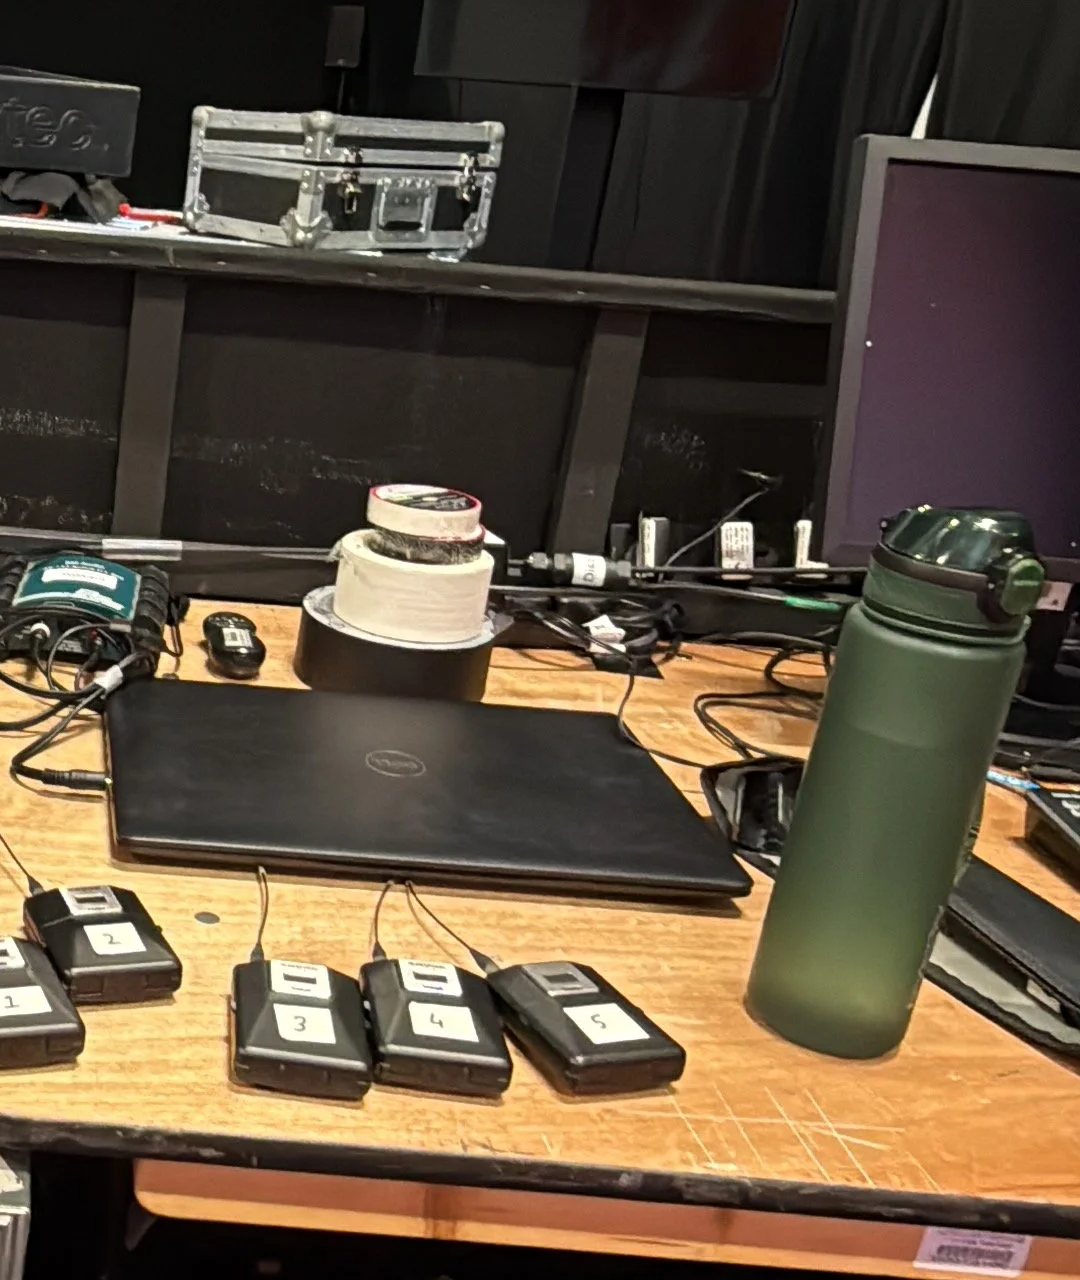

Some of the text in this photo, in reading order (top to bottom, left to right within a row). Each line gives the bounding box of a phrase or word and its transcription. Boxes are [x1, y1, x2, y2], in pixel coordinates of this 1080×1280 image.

[103, 932, 122, 946] 2
[3, 994, 20, 1010] 1
[292, 1015, 307, 1032] 3
[429, 1012, 444, 1029] 4
[590, 1013, 607, 1030] 5
